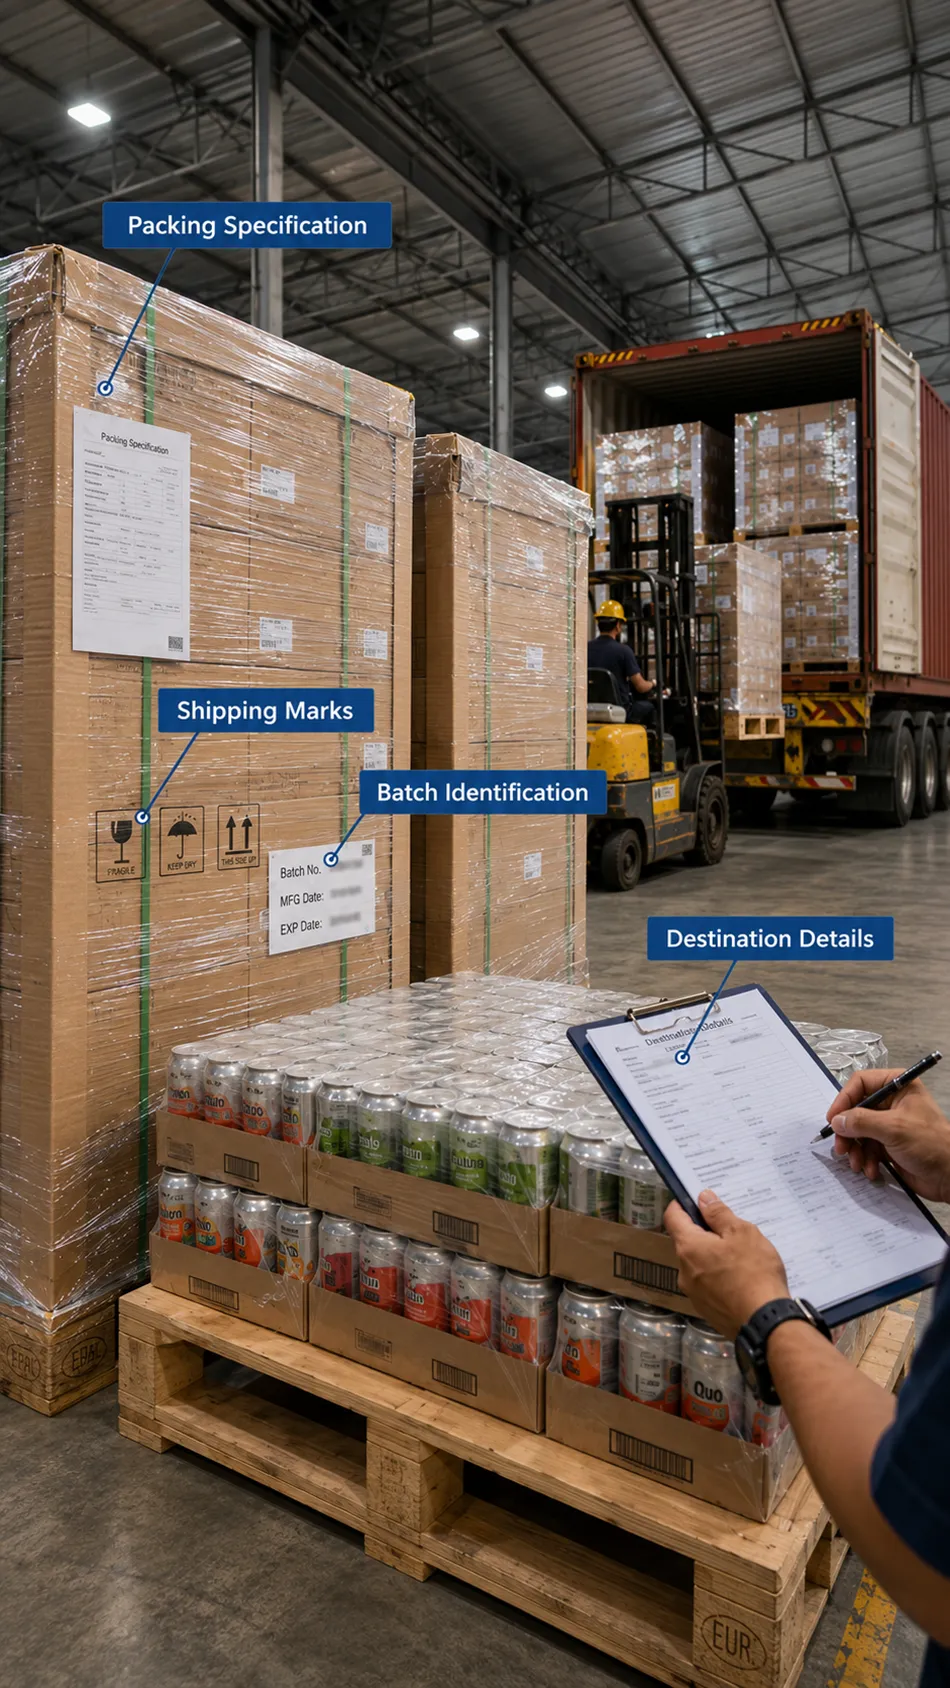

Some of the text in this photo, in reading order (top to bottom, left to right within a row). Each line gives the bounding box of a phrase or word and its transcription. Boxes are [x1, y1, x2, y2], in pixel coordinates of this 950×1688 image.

[101, 432, 170, 456] Packing Specification
[107, 866, 136, 876] FRAGILE
[167, 862, 183, 871] KEEP
[280, 865, 305, 879] Batch
[307, 864, 322, 876] No.
[280, 894, 300, 907] MFG
[302, 892, 324, 904] Date:
[280, 922, 299, 936] EXP
[300, 920, 323, 932] Date:
[694, 1380, 724, 1404] Quo
